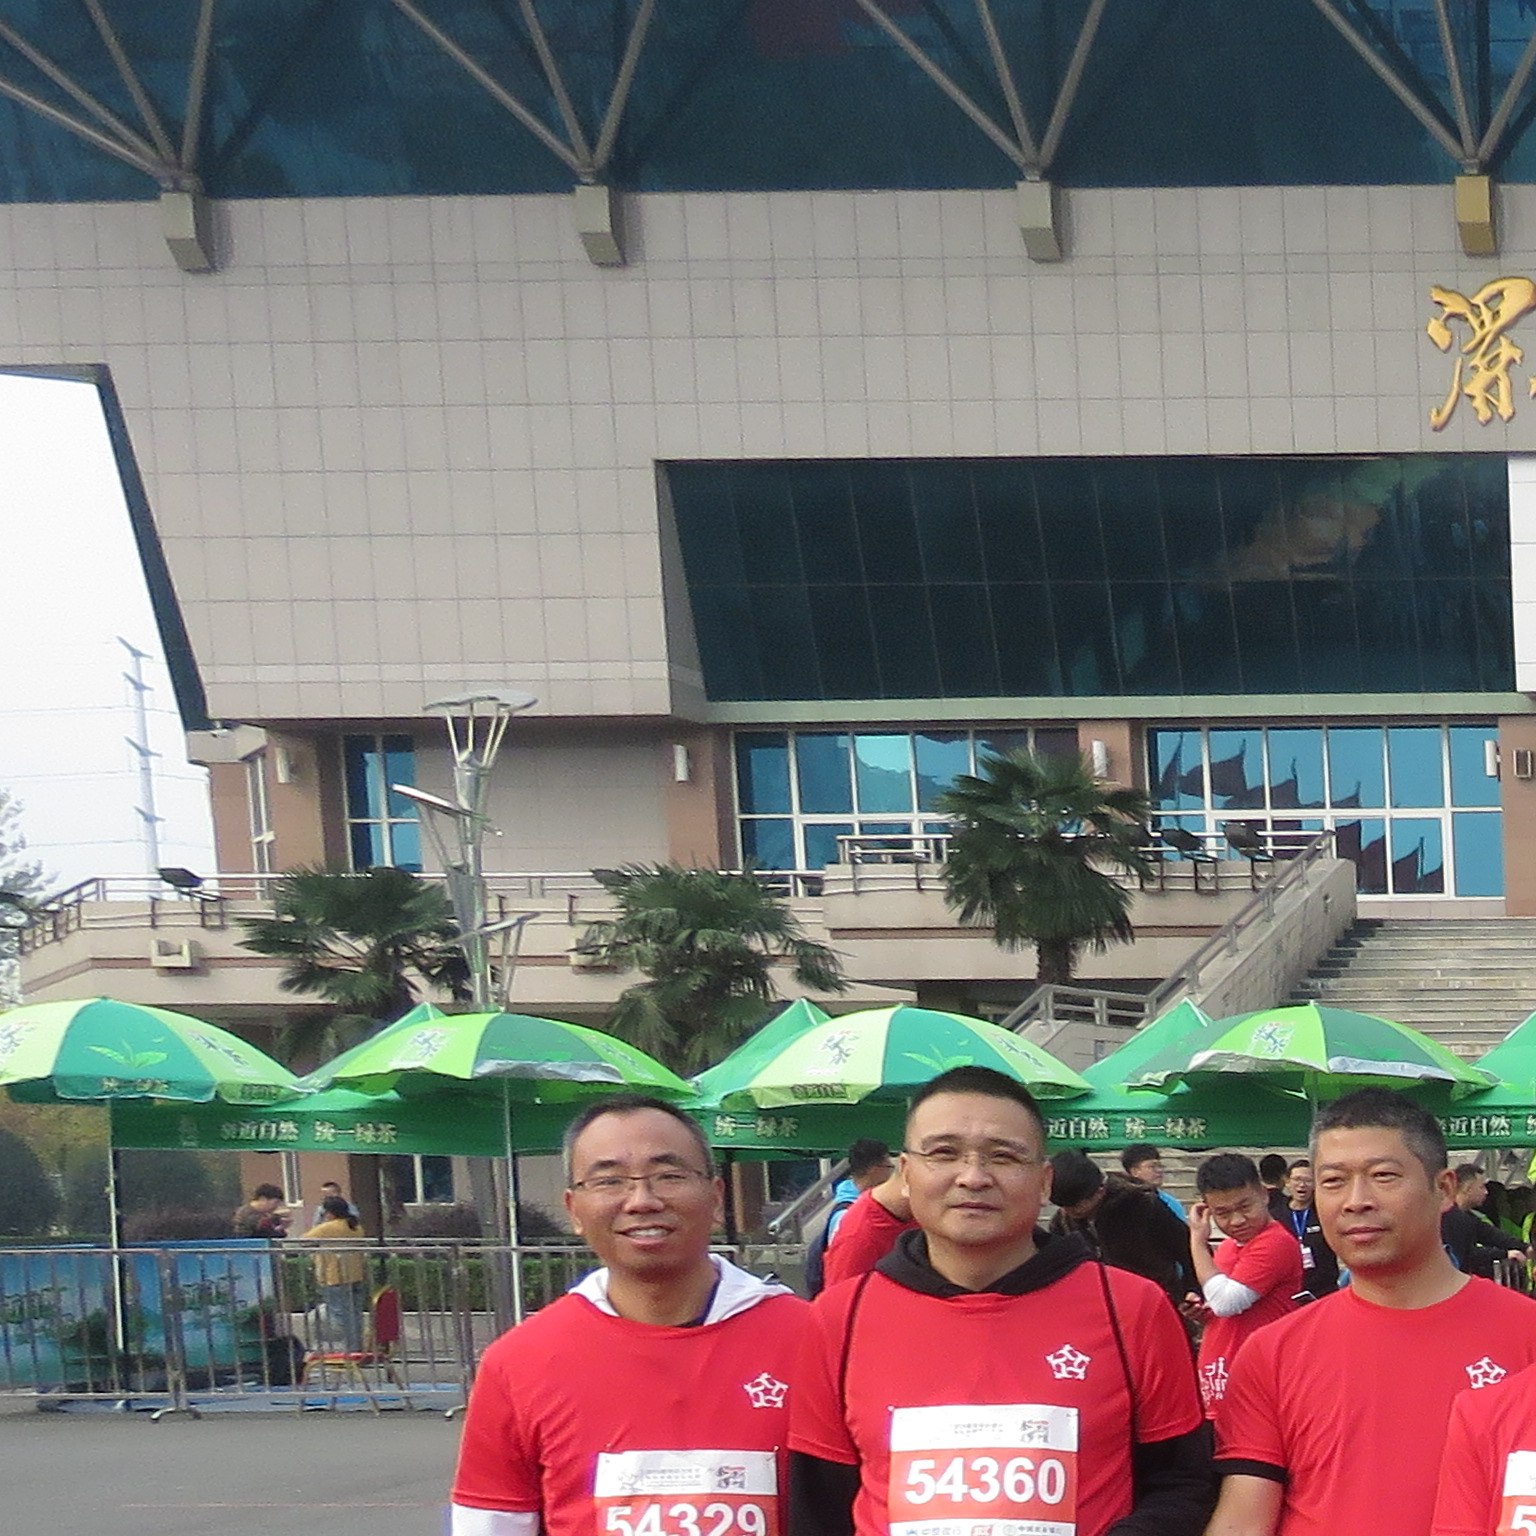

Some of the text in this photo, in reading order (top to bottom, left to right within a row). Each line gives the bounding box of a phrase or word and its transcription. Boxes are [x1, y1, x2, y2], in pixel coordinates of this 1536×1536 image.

[713, 1115, 798, 1138] 统一绿茶
[1048, 1114, 1207, 1138] 近自然 统一绿茶
[904, 1457, 1067, 1505] 54360
